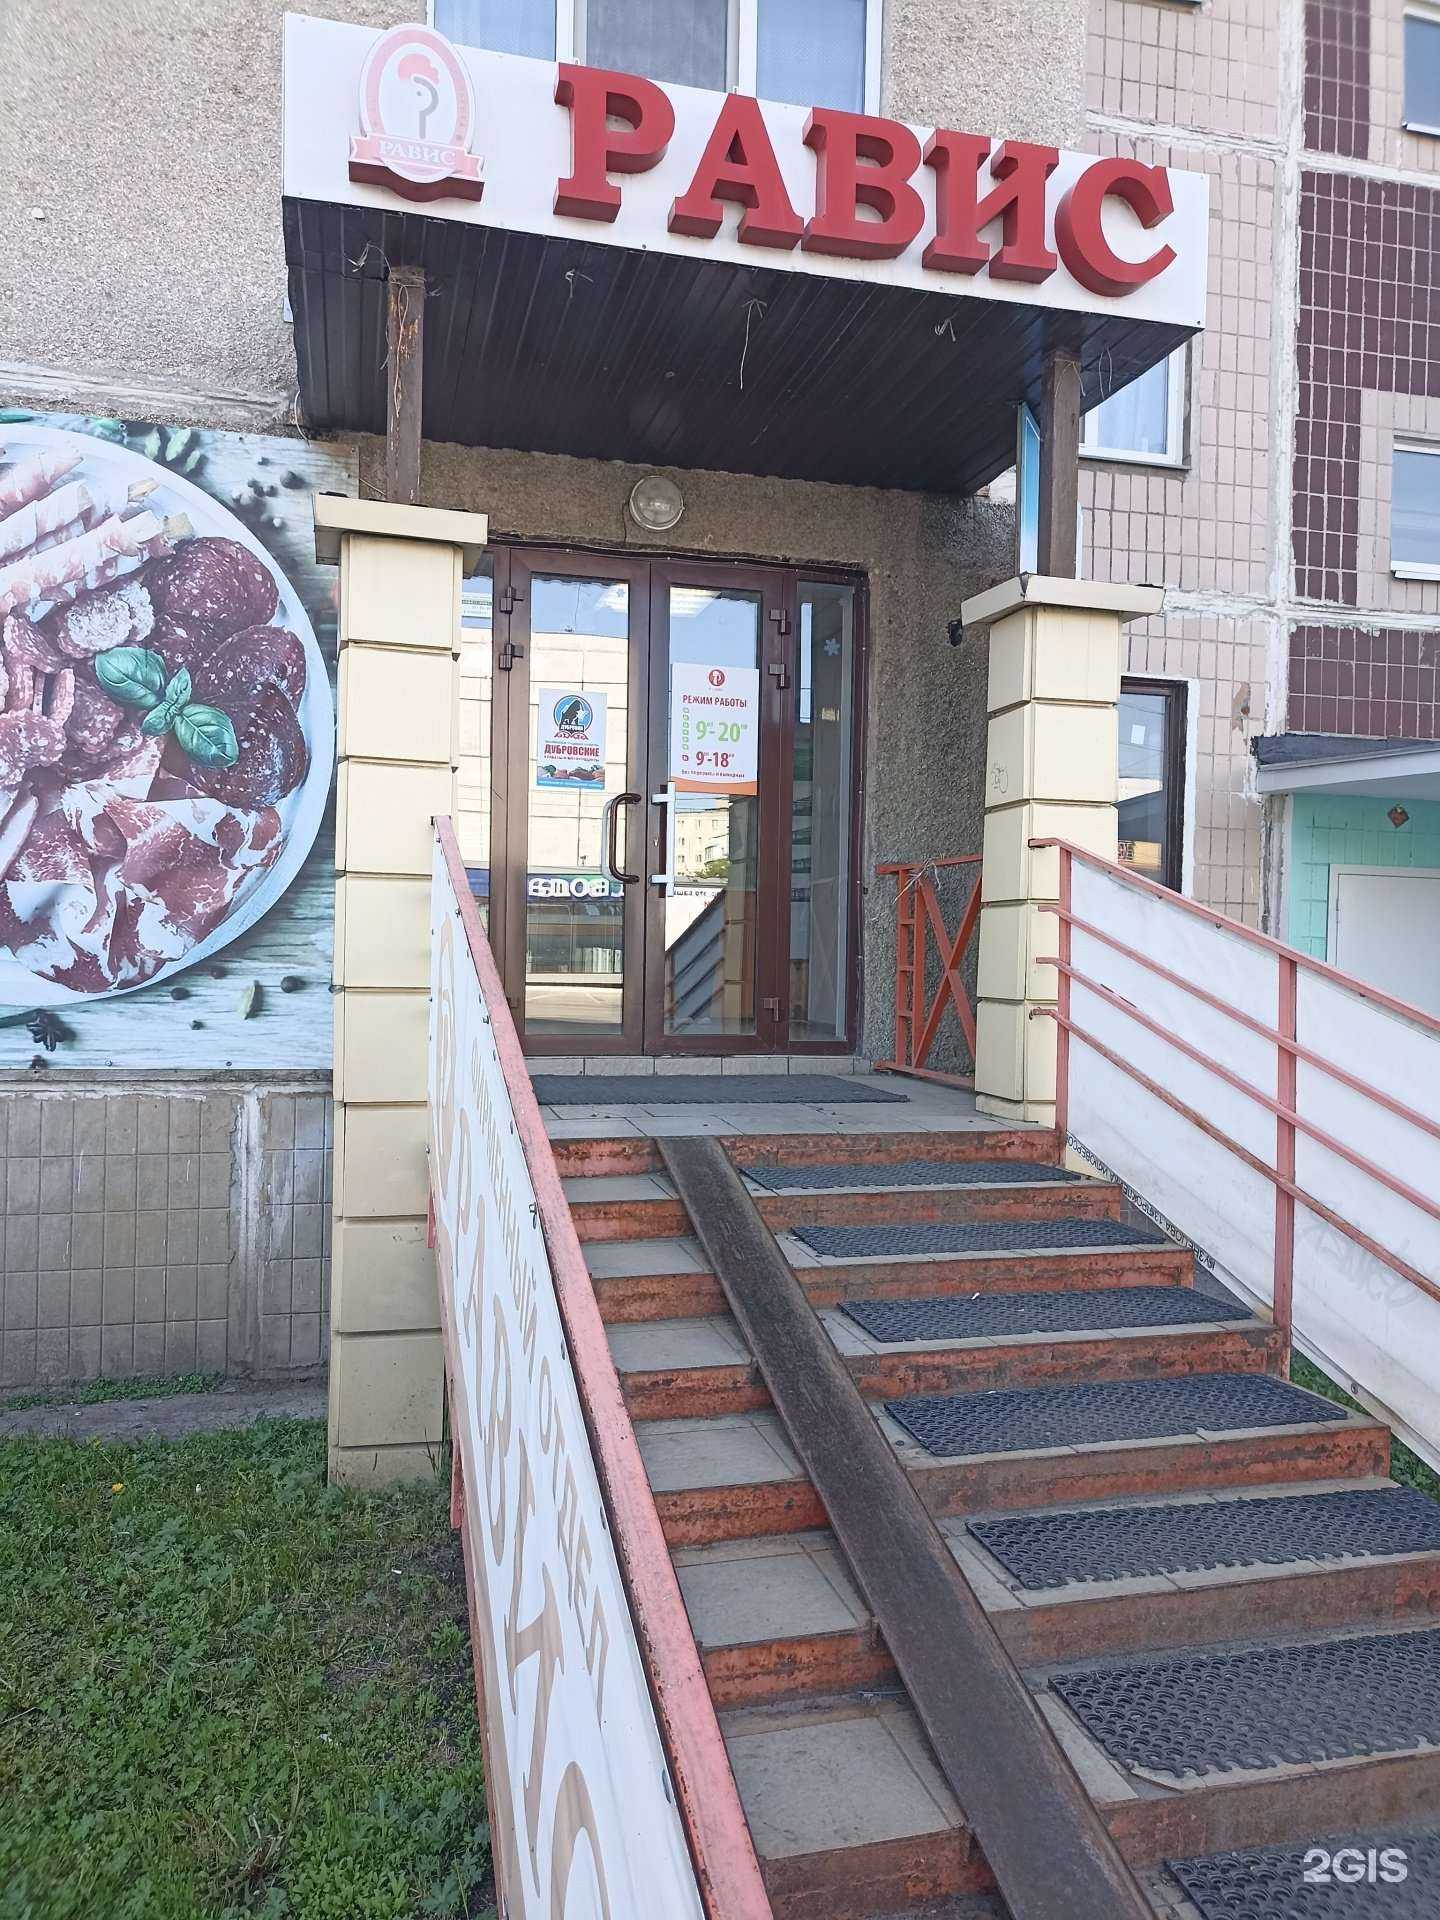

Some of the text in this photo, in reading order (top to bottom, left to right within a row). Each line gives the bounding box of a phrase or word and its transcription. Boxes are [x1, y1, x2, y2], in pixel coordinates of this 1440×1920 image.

[379, 140, 457, 166] РАВИС
[553, 62, 1177, 298] РАВИС
[682, 694, 747, 708] РЕЖИМ РАБОТЫ
[544, 743, 600, 757] ДУБРОВСКИЕ
[472, 1036, 609, 1732] ФИРМЕННЫЙ ОТДЕЛ
